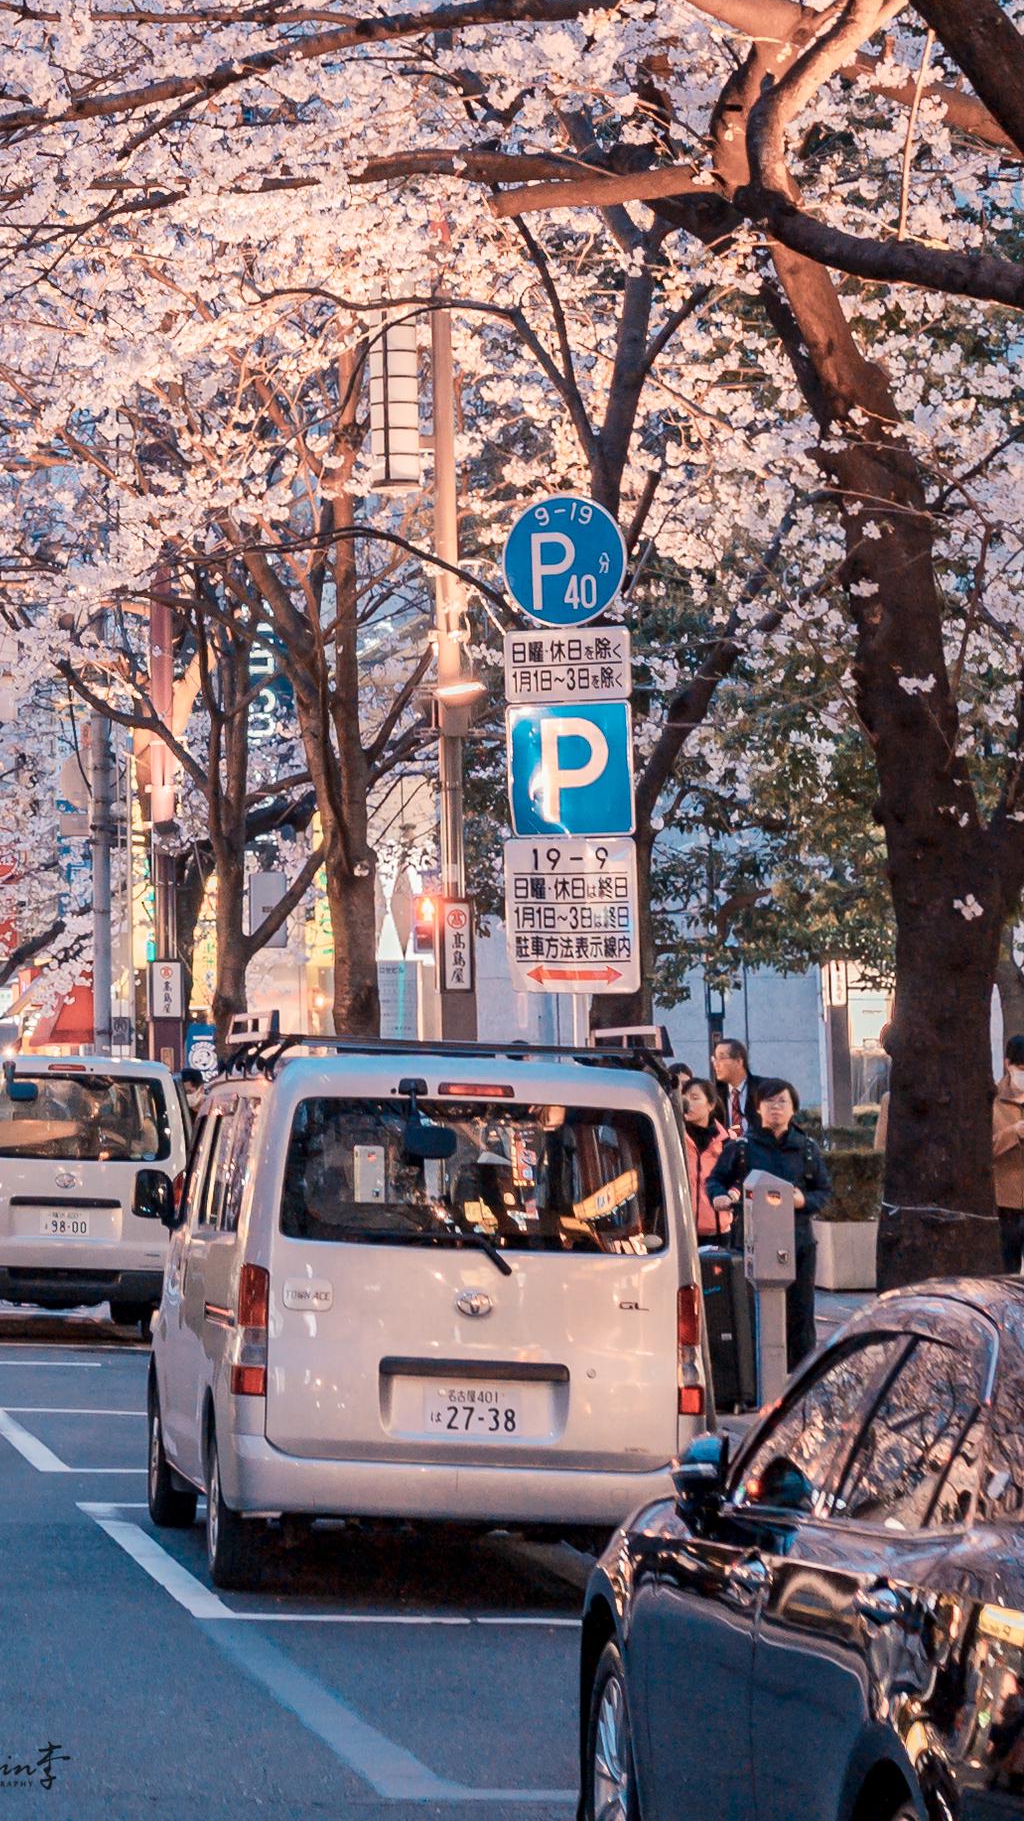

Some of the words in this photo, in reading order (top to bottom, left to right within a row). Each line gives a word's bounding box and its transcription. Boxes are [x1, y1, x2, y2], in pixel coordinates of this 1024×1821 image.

[534, 502, 593, 526] 9-19
[530, 532, 576, 611] P
[598, 552, 610, 574] 分
[564, 574, 597, 609] 40
[540, 717, 608, 822] P
[51, 1220, 87, 1234] 98-00
[446, 1406, 516, 1432] 27-38
